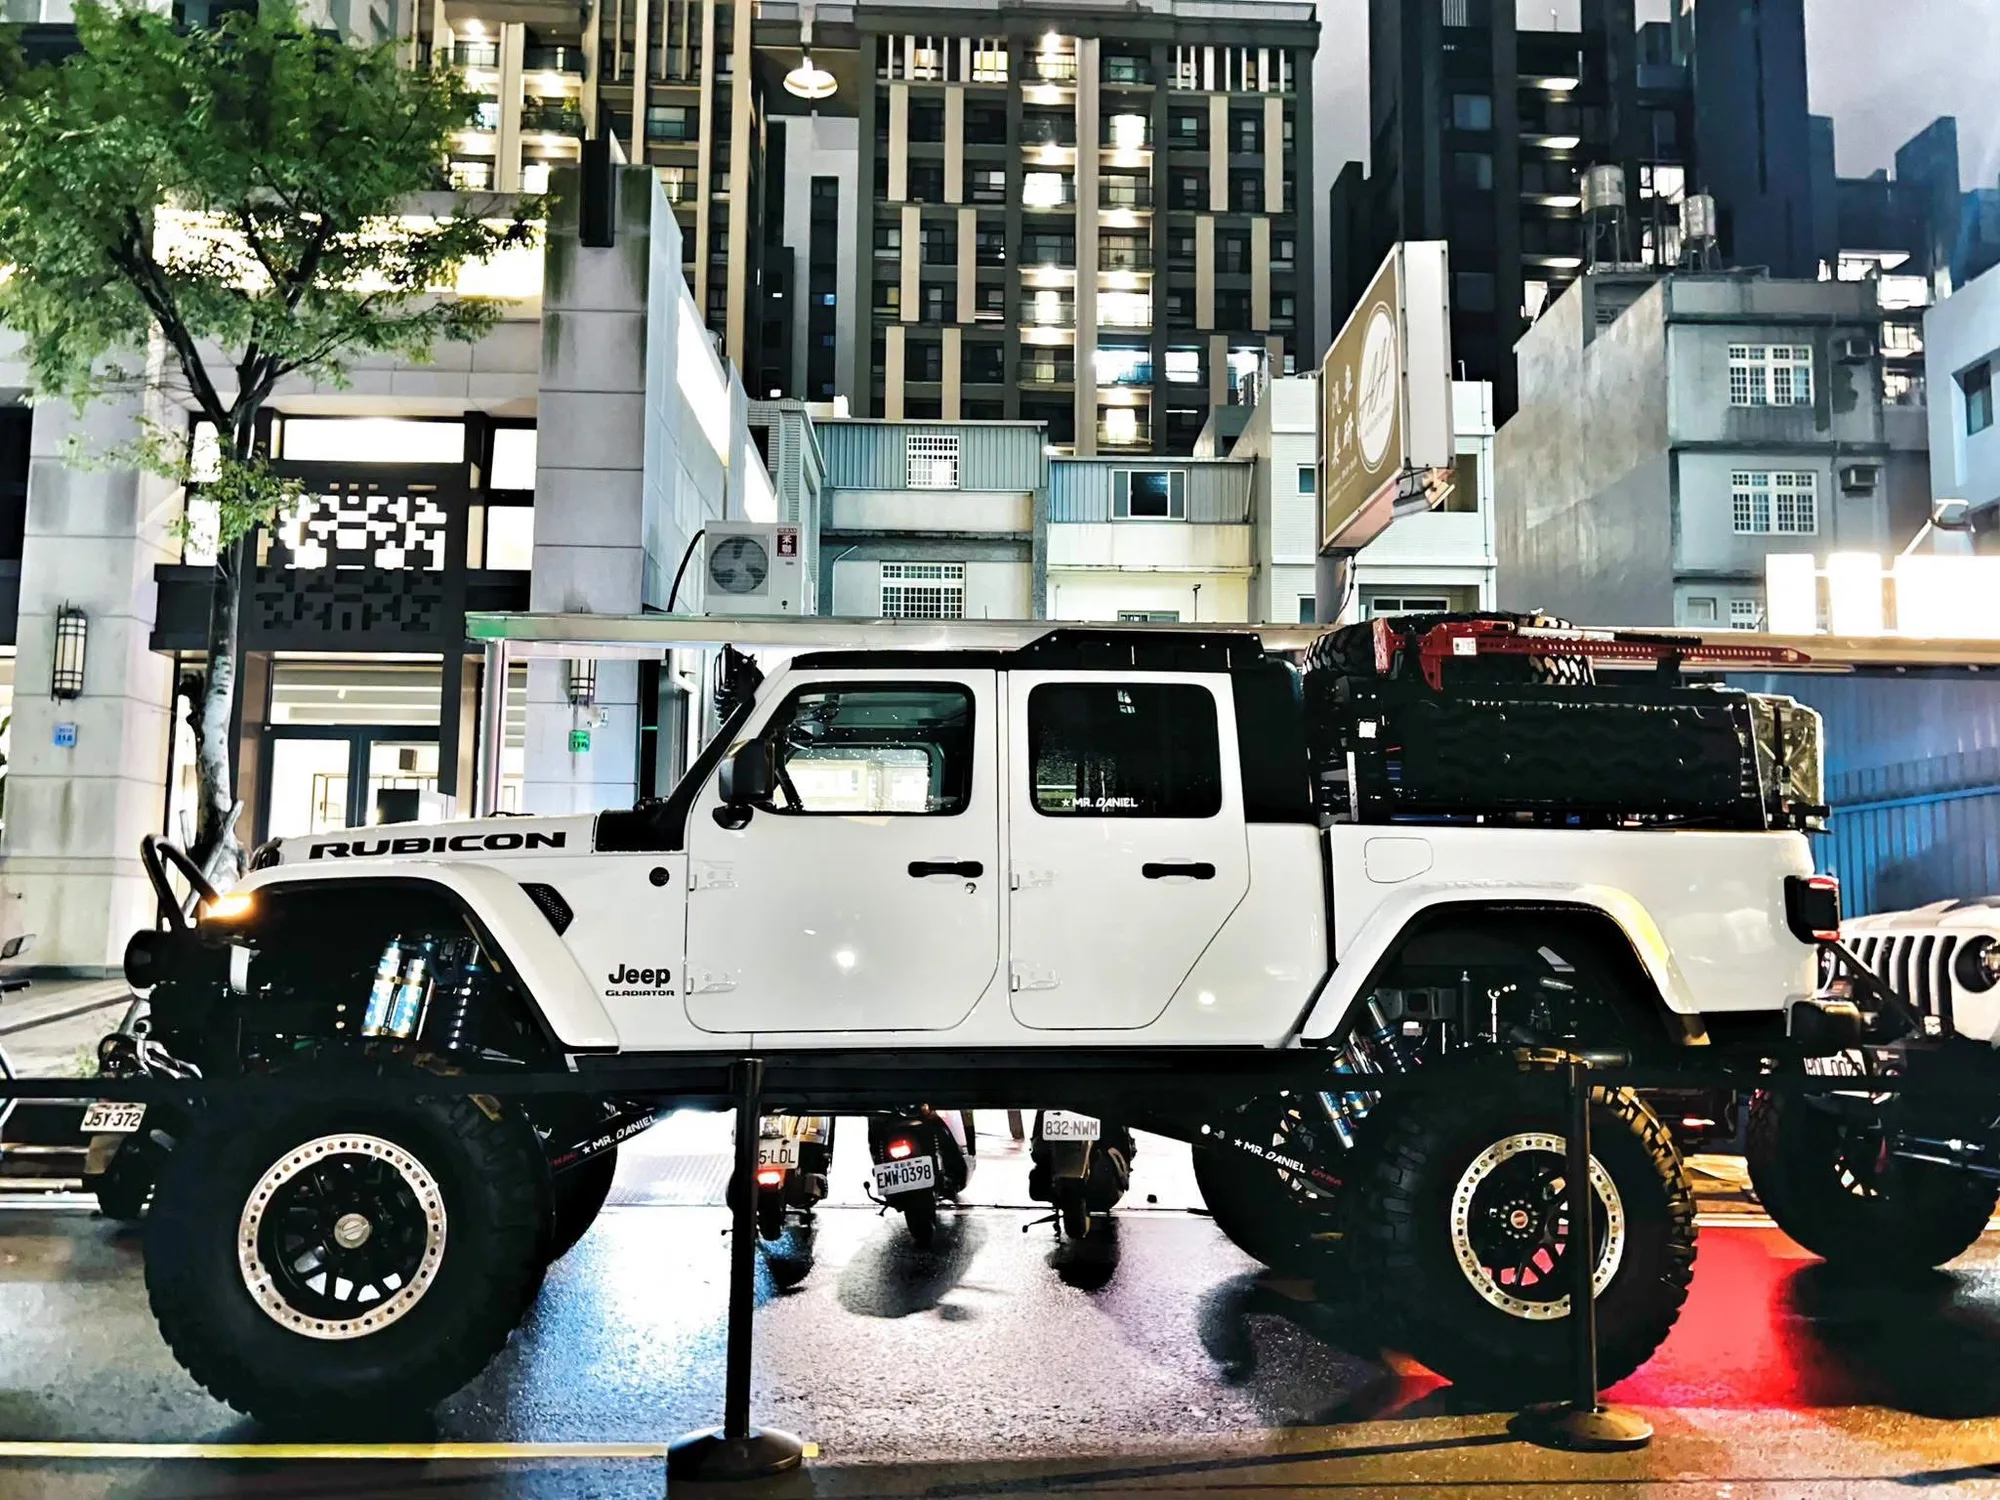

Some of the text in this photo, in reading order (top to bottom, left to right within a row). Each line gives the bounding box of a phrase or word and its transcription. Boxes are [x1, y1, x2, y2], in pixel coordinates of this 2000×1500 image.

[1071, 797, 1139, 808] MR. DANIEL
[308, 832, 566, 860] RUBICON
[608, 963, 671, 988] Jeep
[605, 989, 675, 997] GLADIATOR
[592, 1114, 658, 1151] MR. DANIEL
[1243, 1141, 1306, 1174] MR. DANIEL
